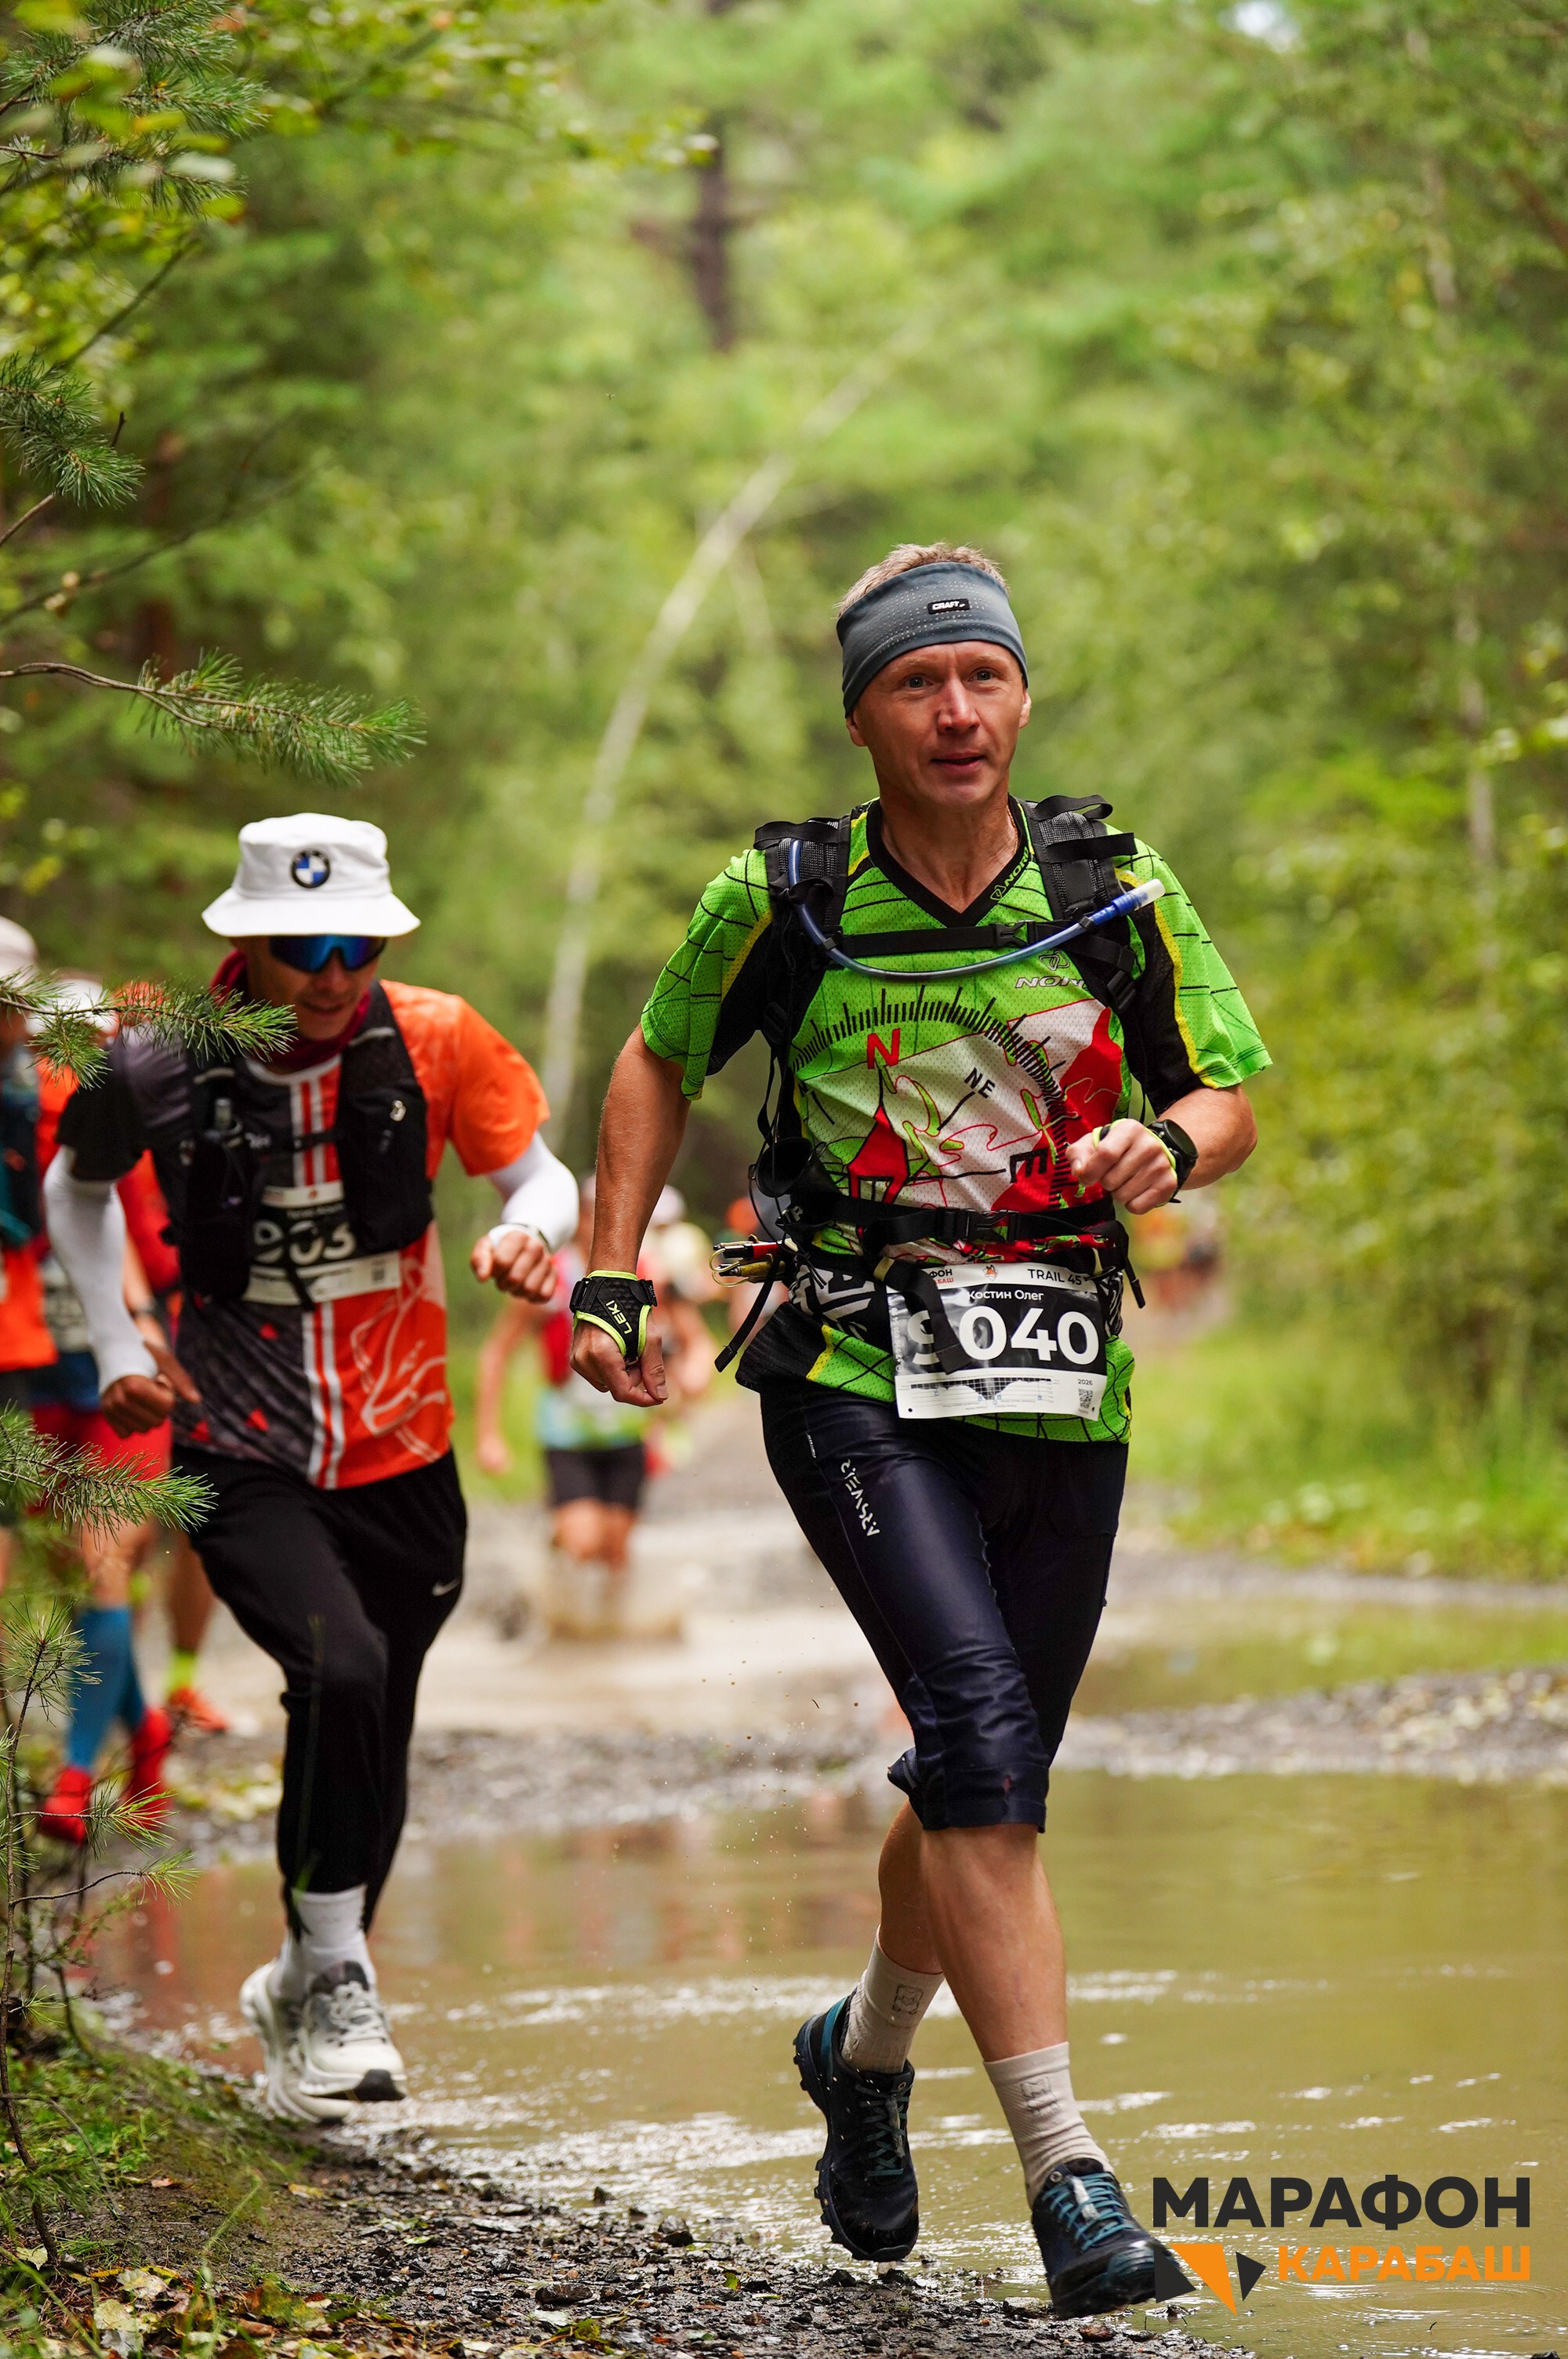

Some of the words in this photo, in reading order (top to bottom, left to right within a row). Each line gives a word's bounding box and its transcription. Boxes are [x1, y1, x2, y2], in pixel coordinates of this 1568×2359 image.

[932, 601, 960, 610] CRAFT
[866, 1028, 901, 1069] N
[964, 1067, 996, 1099] NE
[1010, 1148, 1048, 1184] E
[1028, 1269, 1065, 1282] TRAIL
[967, 1290, 1012, 1301] Костин
[1014, 1290, 1044, 1301] Олег
[606, 1299, 633, 1334] LEKI
